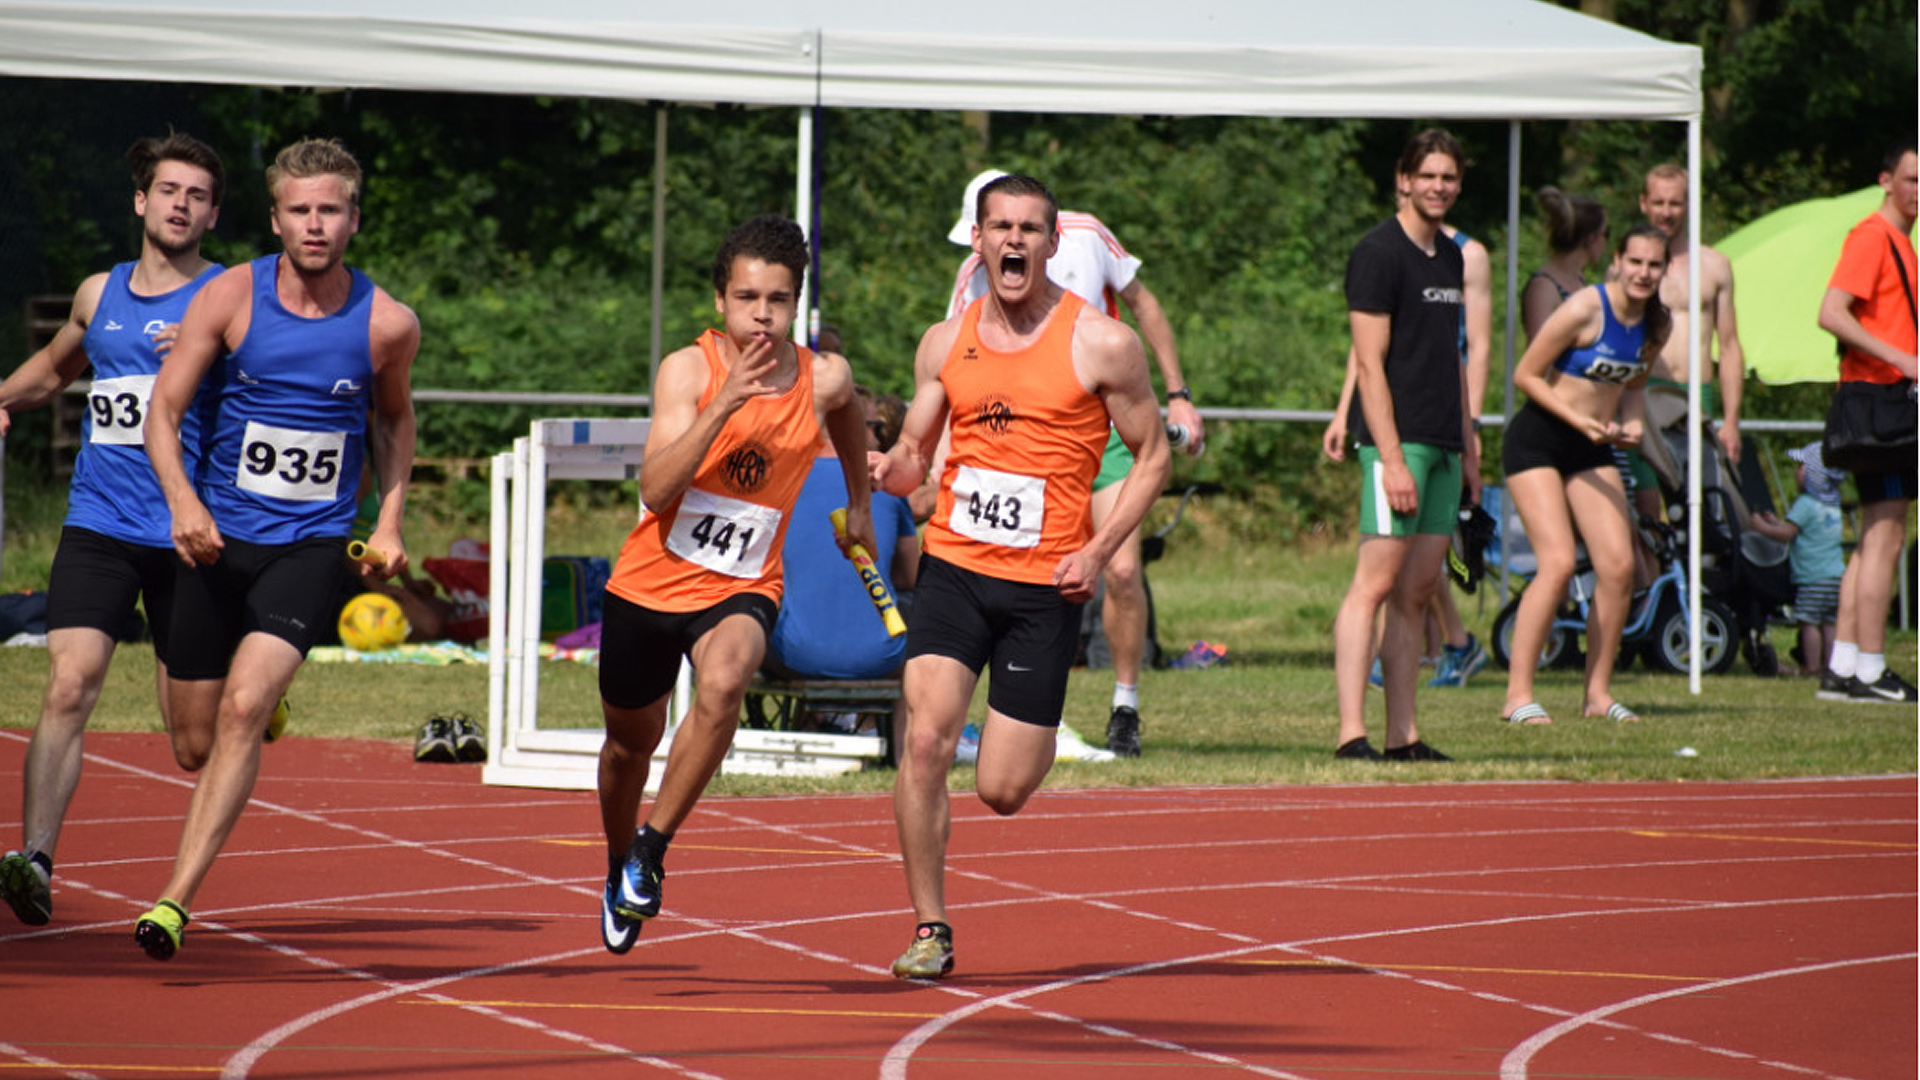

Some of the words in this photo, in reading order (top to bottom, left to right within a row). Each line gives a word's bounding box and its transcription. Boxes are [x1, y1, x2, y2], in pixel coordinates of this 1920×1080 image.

[91, 392, 149, 428] 93
[245, 441, 339, 484] 935
[726, 449, 766, 487] HERA
[968, 490, 1022, 531] 443
[691, 514, 755, 562] 441
